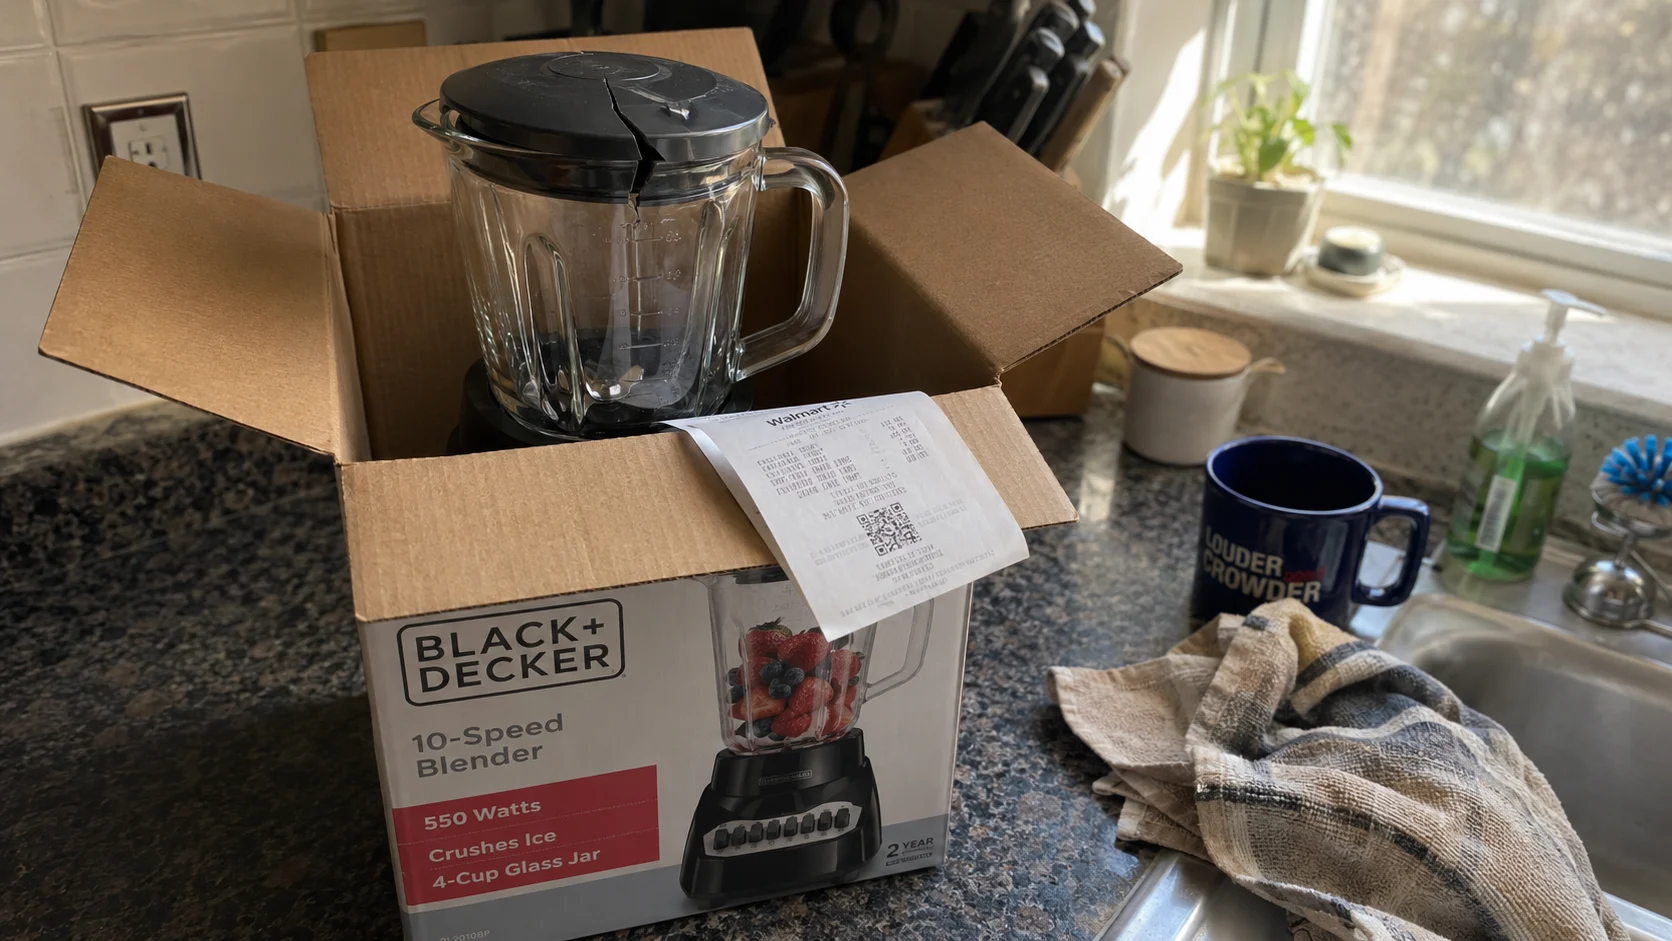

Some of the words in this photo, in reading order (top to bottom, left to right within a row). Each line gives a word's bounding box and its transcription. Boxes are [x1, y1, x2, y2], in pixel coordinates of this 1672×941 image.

[766, 405, 831, 427] Walmart
[1205, 525, 1283, 576] LOUDER
[1203, 549, 1321, 602] CROWDER
[415, 616, 604, 662] BLACK+
[419, 643, 610, 693] DECKER
[412, 713, 564, 753] 10-Speed
[416, 744, 543, 778] Blender
[424, 811, 468, 831] 550
[472, 800, 542, 823] Watts
[428, 837, 520, 863] Crushes
[524, 830, 557, 847] Ice
[886, 843, 899, 858] 2
[902, 837, 934, 849] YEAR
[432, 867, 500, 890] 4-Cup
[504, 858, 563, 877] Glass
[567, 849, 601, 865] Jar
